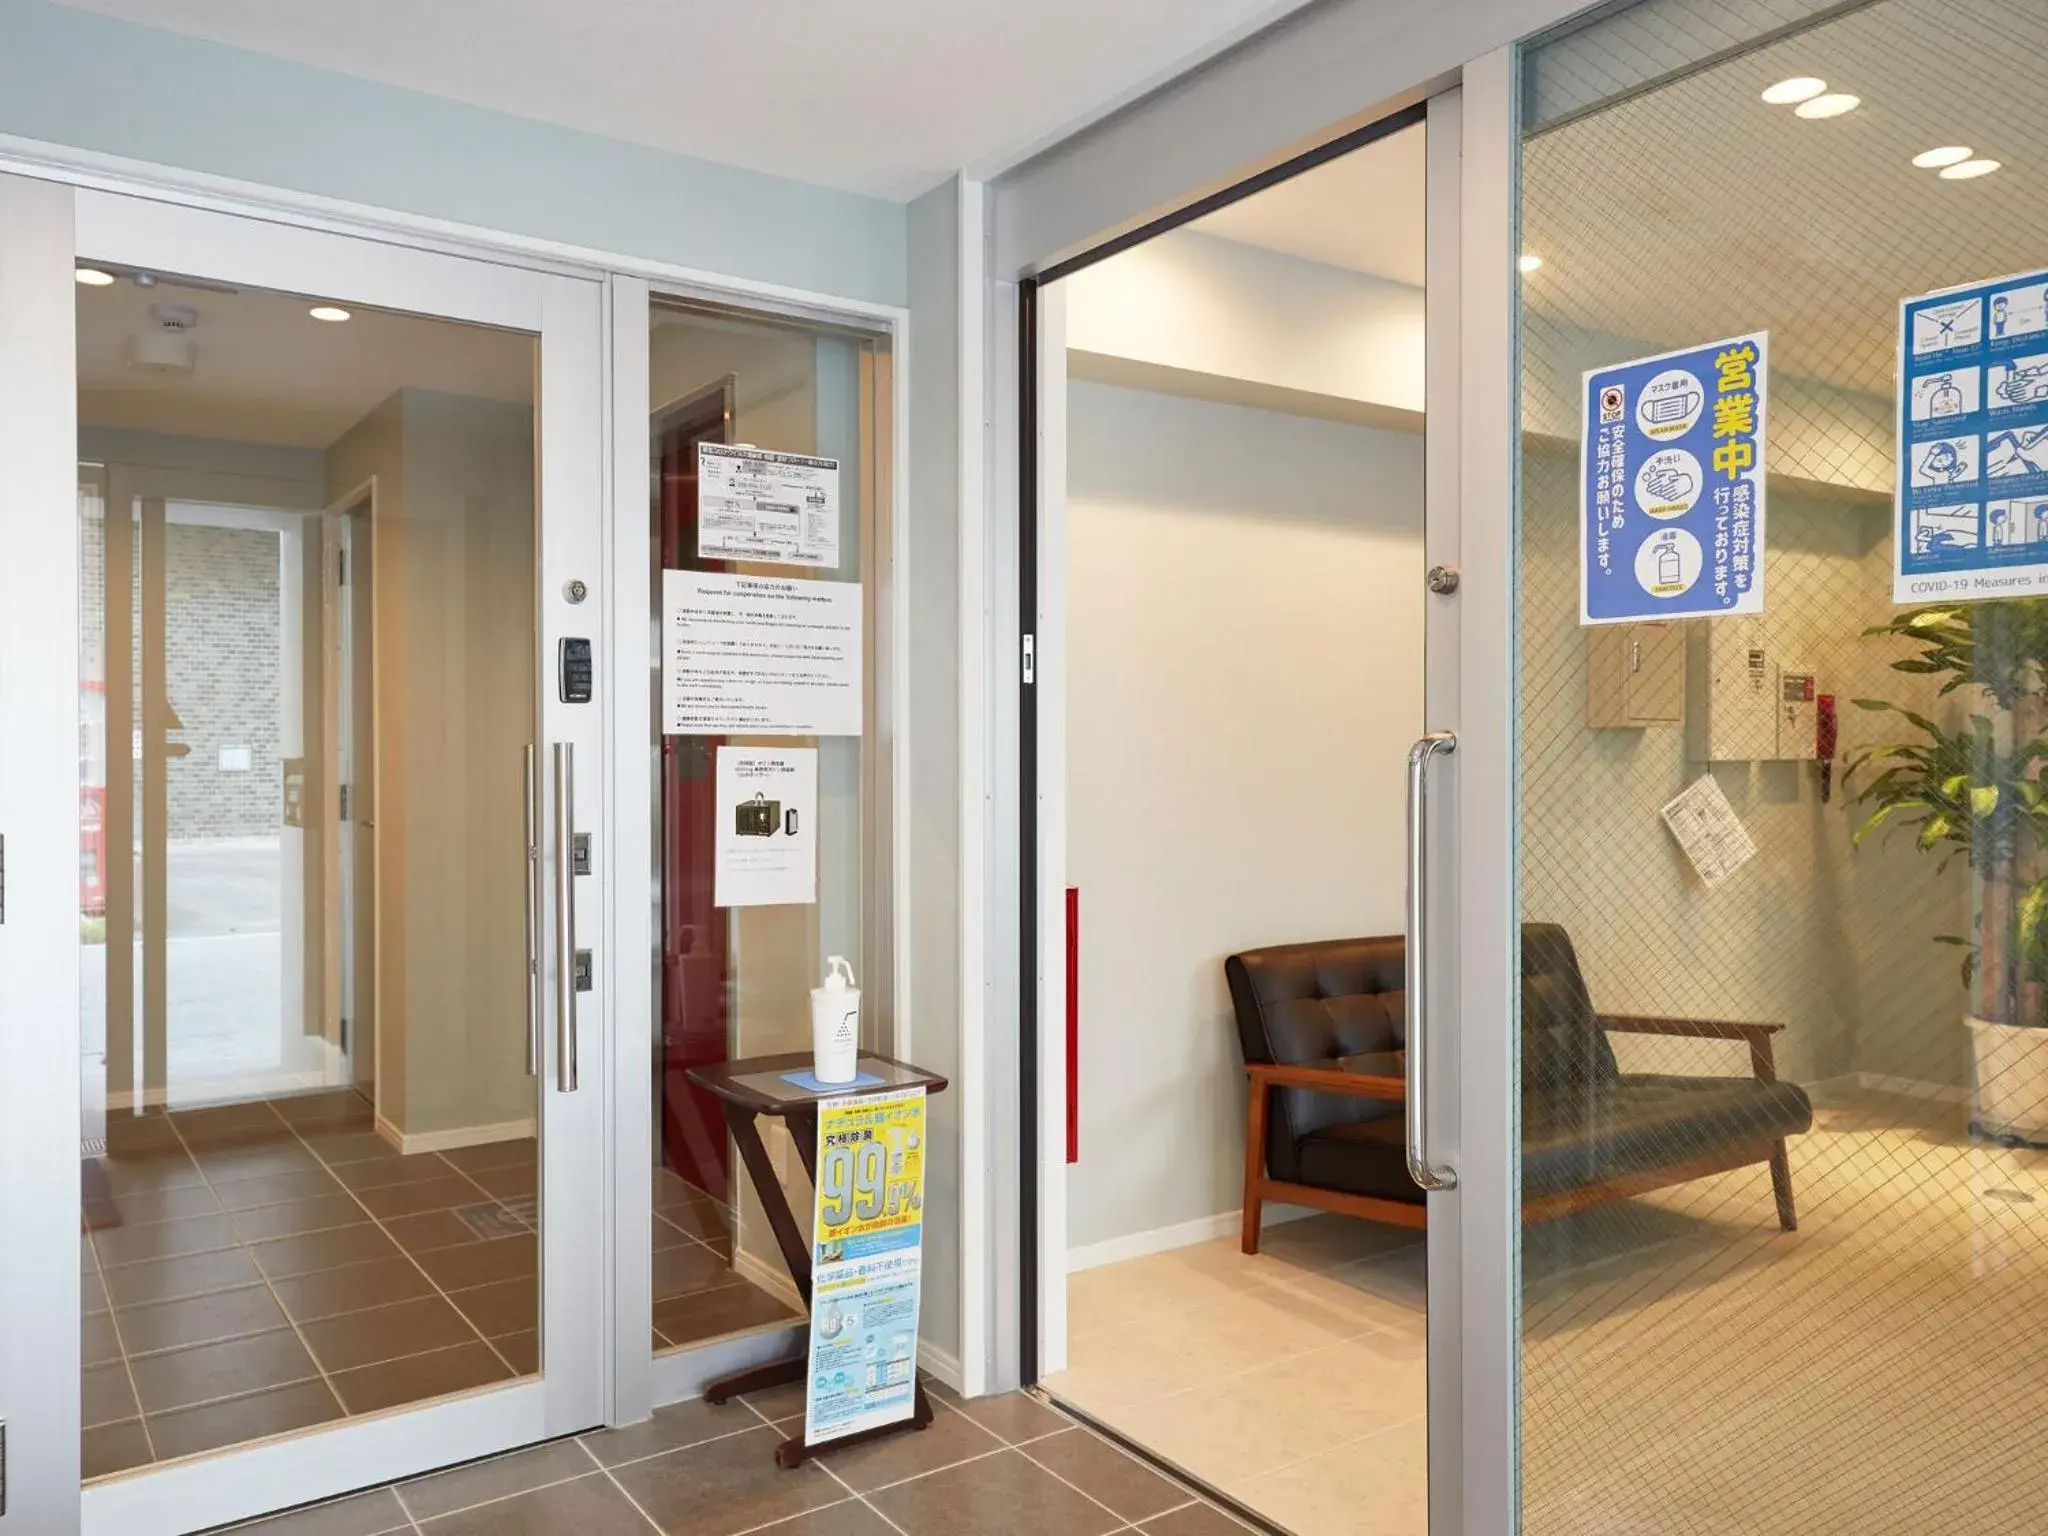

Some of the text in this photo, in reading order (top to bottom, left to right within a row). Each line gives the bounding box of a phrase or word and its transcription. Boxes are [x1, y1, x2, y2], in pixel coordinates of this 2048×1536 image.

[1651, 378, 1688, 393] マスク着用
[1713, 345, 1756, 480] 営業中
[1596, 427, 1612, 576] ご協力お願いします。
[1611, 424, 1626, 529] 安全確保のため
[1656, 454, 1680, 465] 手洗い
[1713, 487, 1731, 605] 行っております。
[1733, 484, 1751, 589] 感染症対策を
[1911, 579, 1968, 593] COVID-19
[1975, 575, 2031, 588] Measures
